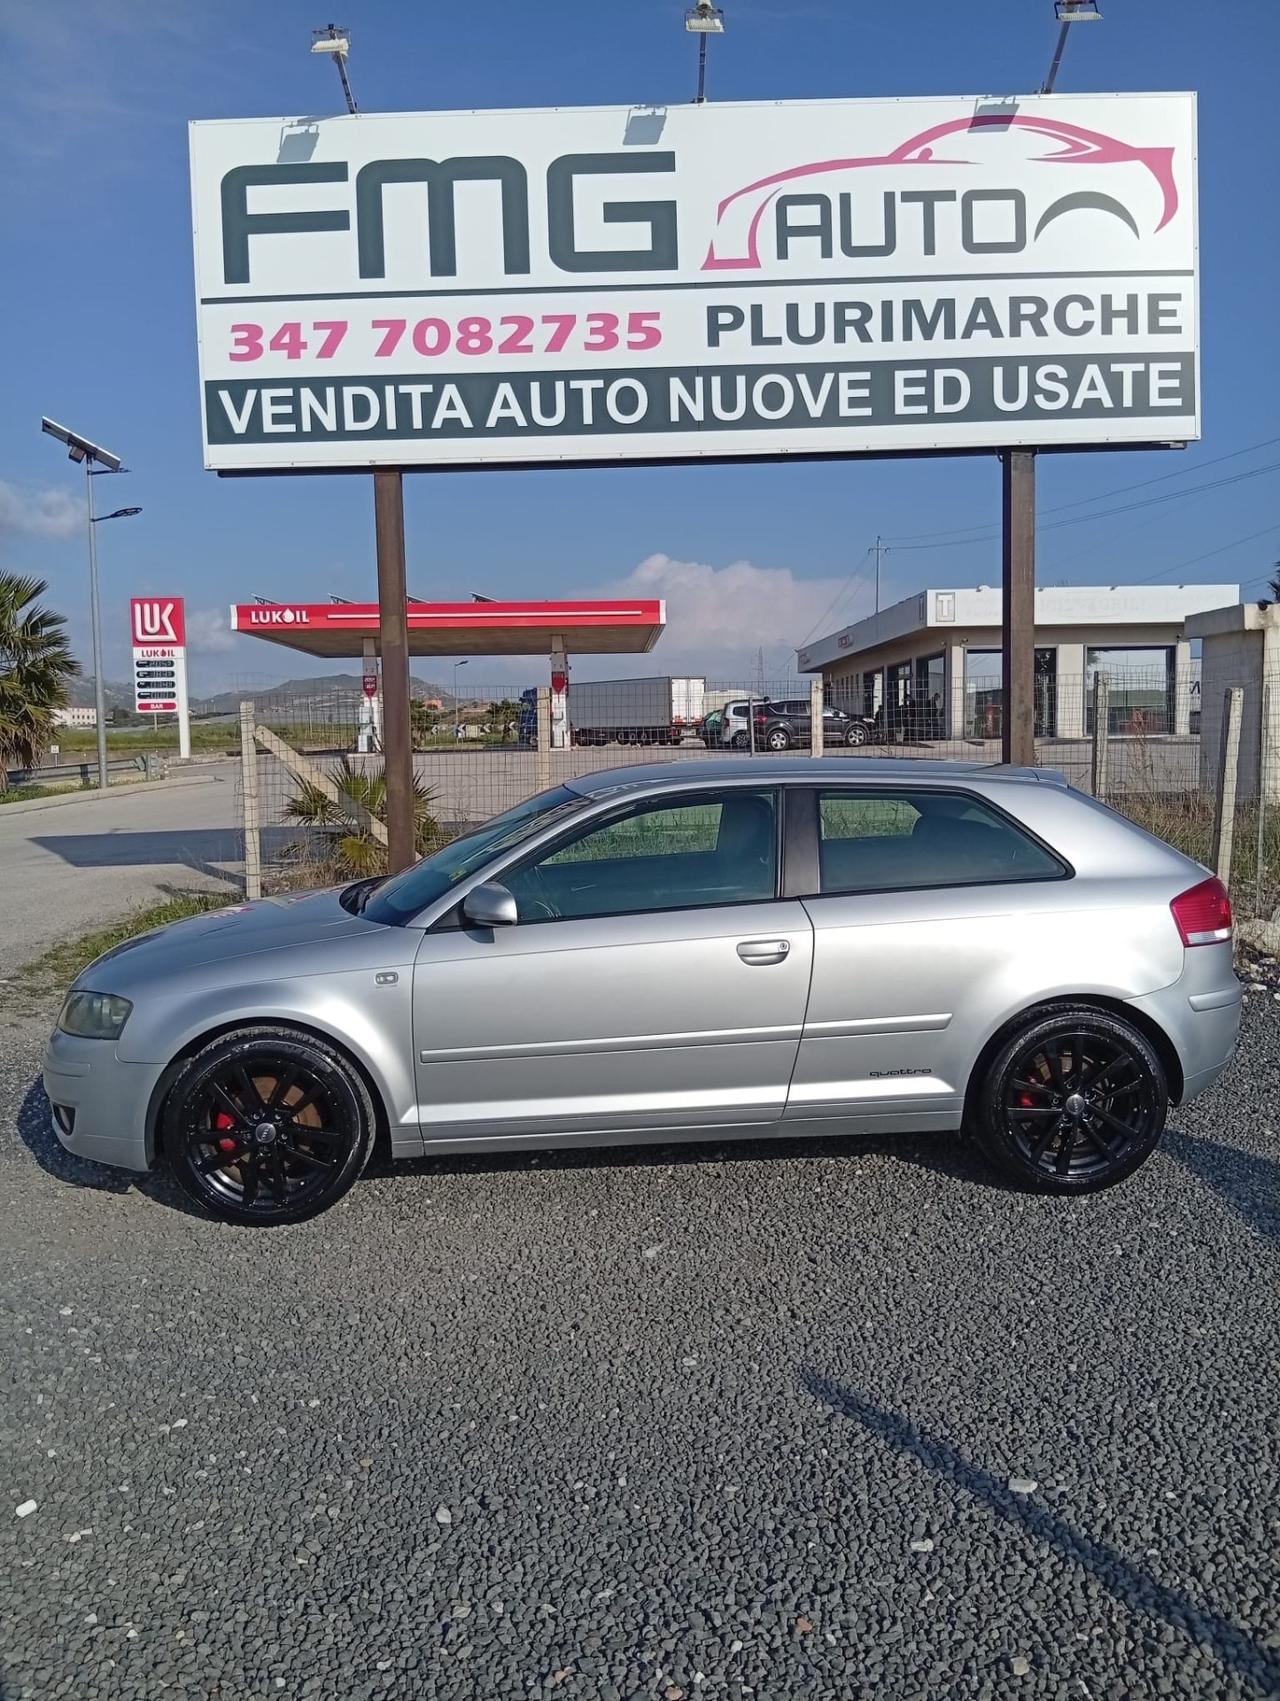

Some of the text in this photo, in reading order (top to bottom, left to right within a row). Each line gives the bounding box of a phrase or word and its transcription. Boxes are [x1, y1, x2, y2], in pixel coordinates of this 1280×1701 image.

[221, 151, 679, 284] FMG
[775, 188, 1027, 261] AUTO
[229, 311, 662, 362] 347 7082735
[706, 292, 1183, 348] PLURIMARCHE
[218, 361, 1183, 435] VENDITA AUTO NUOVE ED USATE
[251, 608, 310, 624] LUKOIL
[141, 649, 175, 657] LUKOIL
[869, 1068, 932, 1078] quattro
